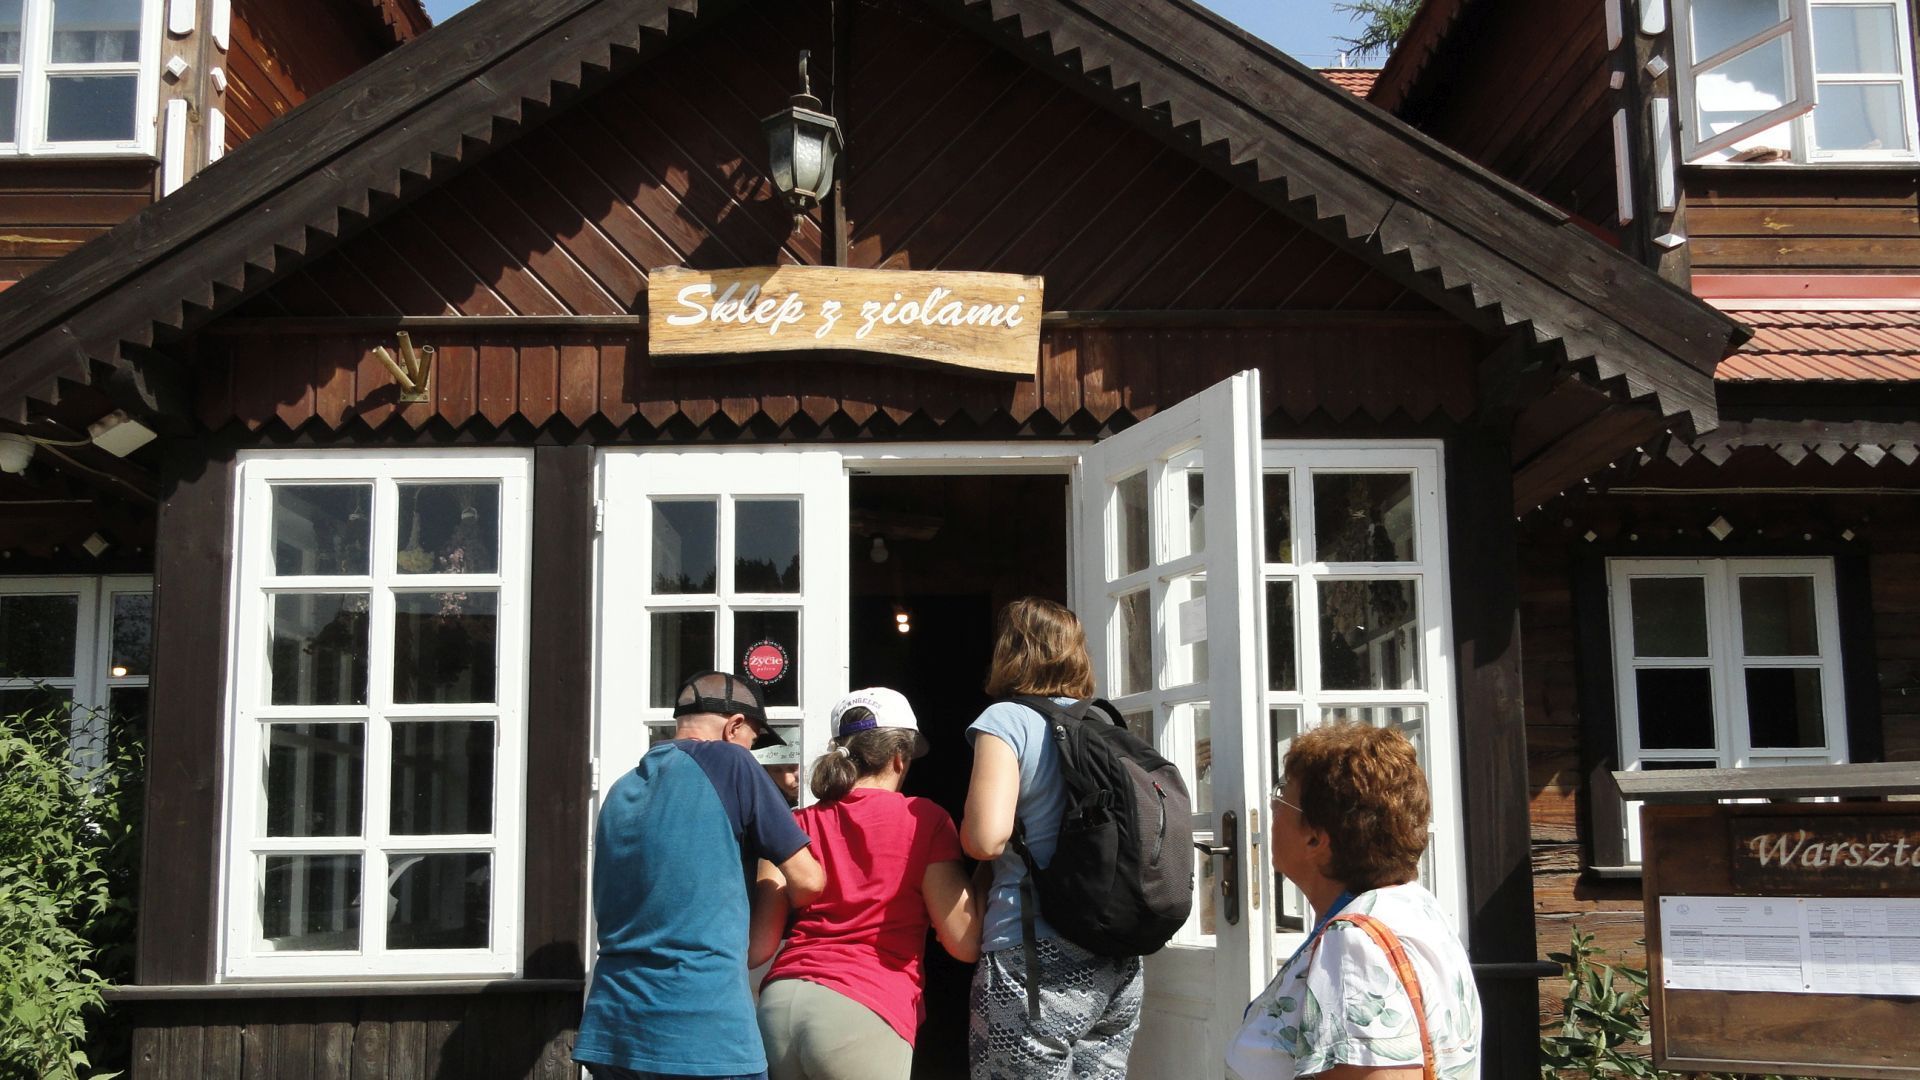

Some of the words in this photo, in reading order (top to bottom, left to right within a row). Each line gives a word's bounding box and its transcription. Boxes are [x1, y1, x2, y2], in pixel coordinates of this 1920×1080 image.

[667, 282, 805, 335] Sklep
[815, 301, 843, 339] z
[855, 287, 1025, 339] ziołami
